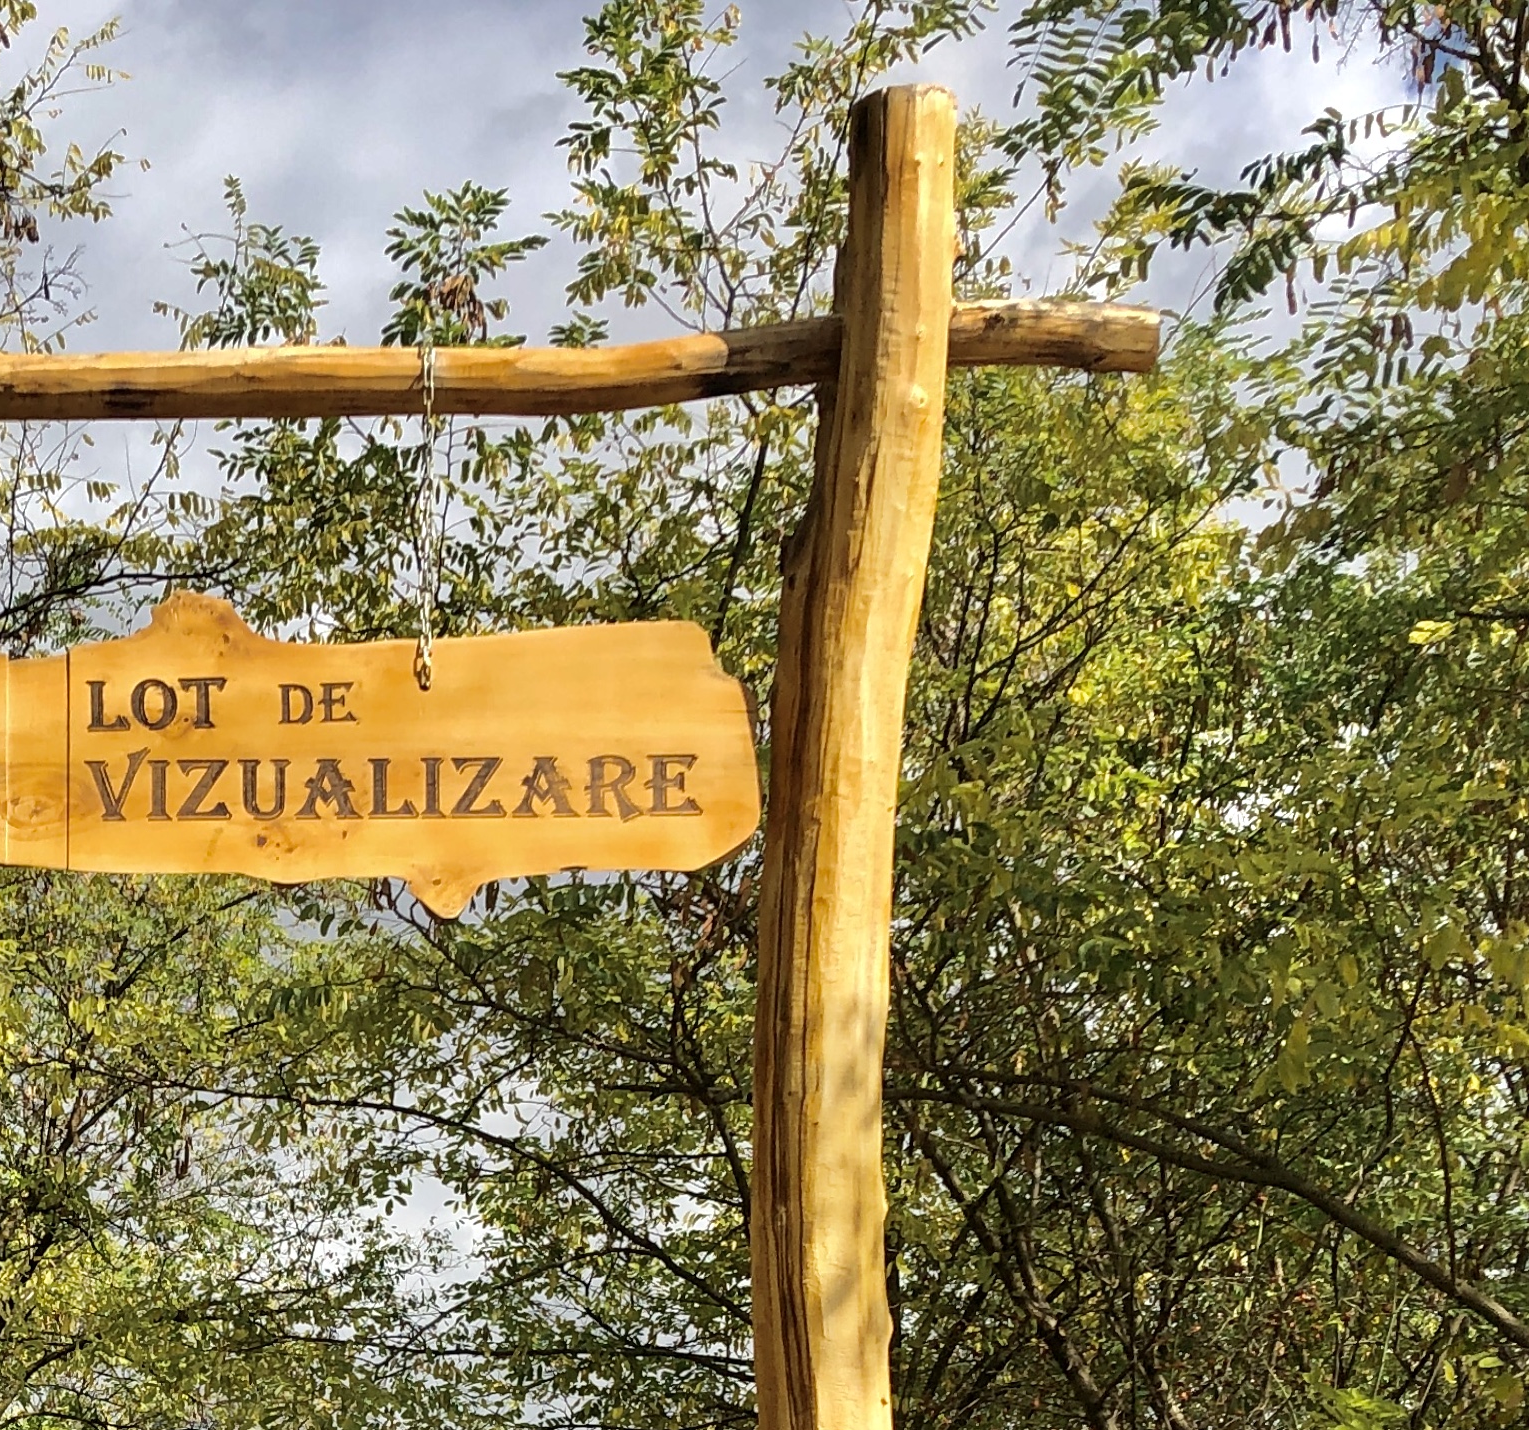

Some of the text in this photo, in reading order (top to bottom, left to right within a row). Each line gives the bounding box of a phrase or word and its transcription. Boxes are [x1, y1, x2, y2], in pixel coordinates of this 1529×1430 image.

[85, 677, 359, 734] LOT DE
[83, 747, 704, 823] VIZUALIZARE
